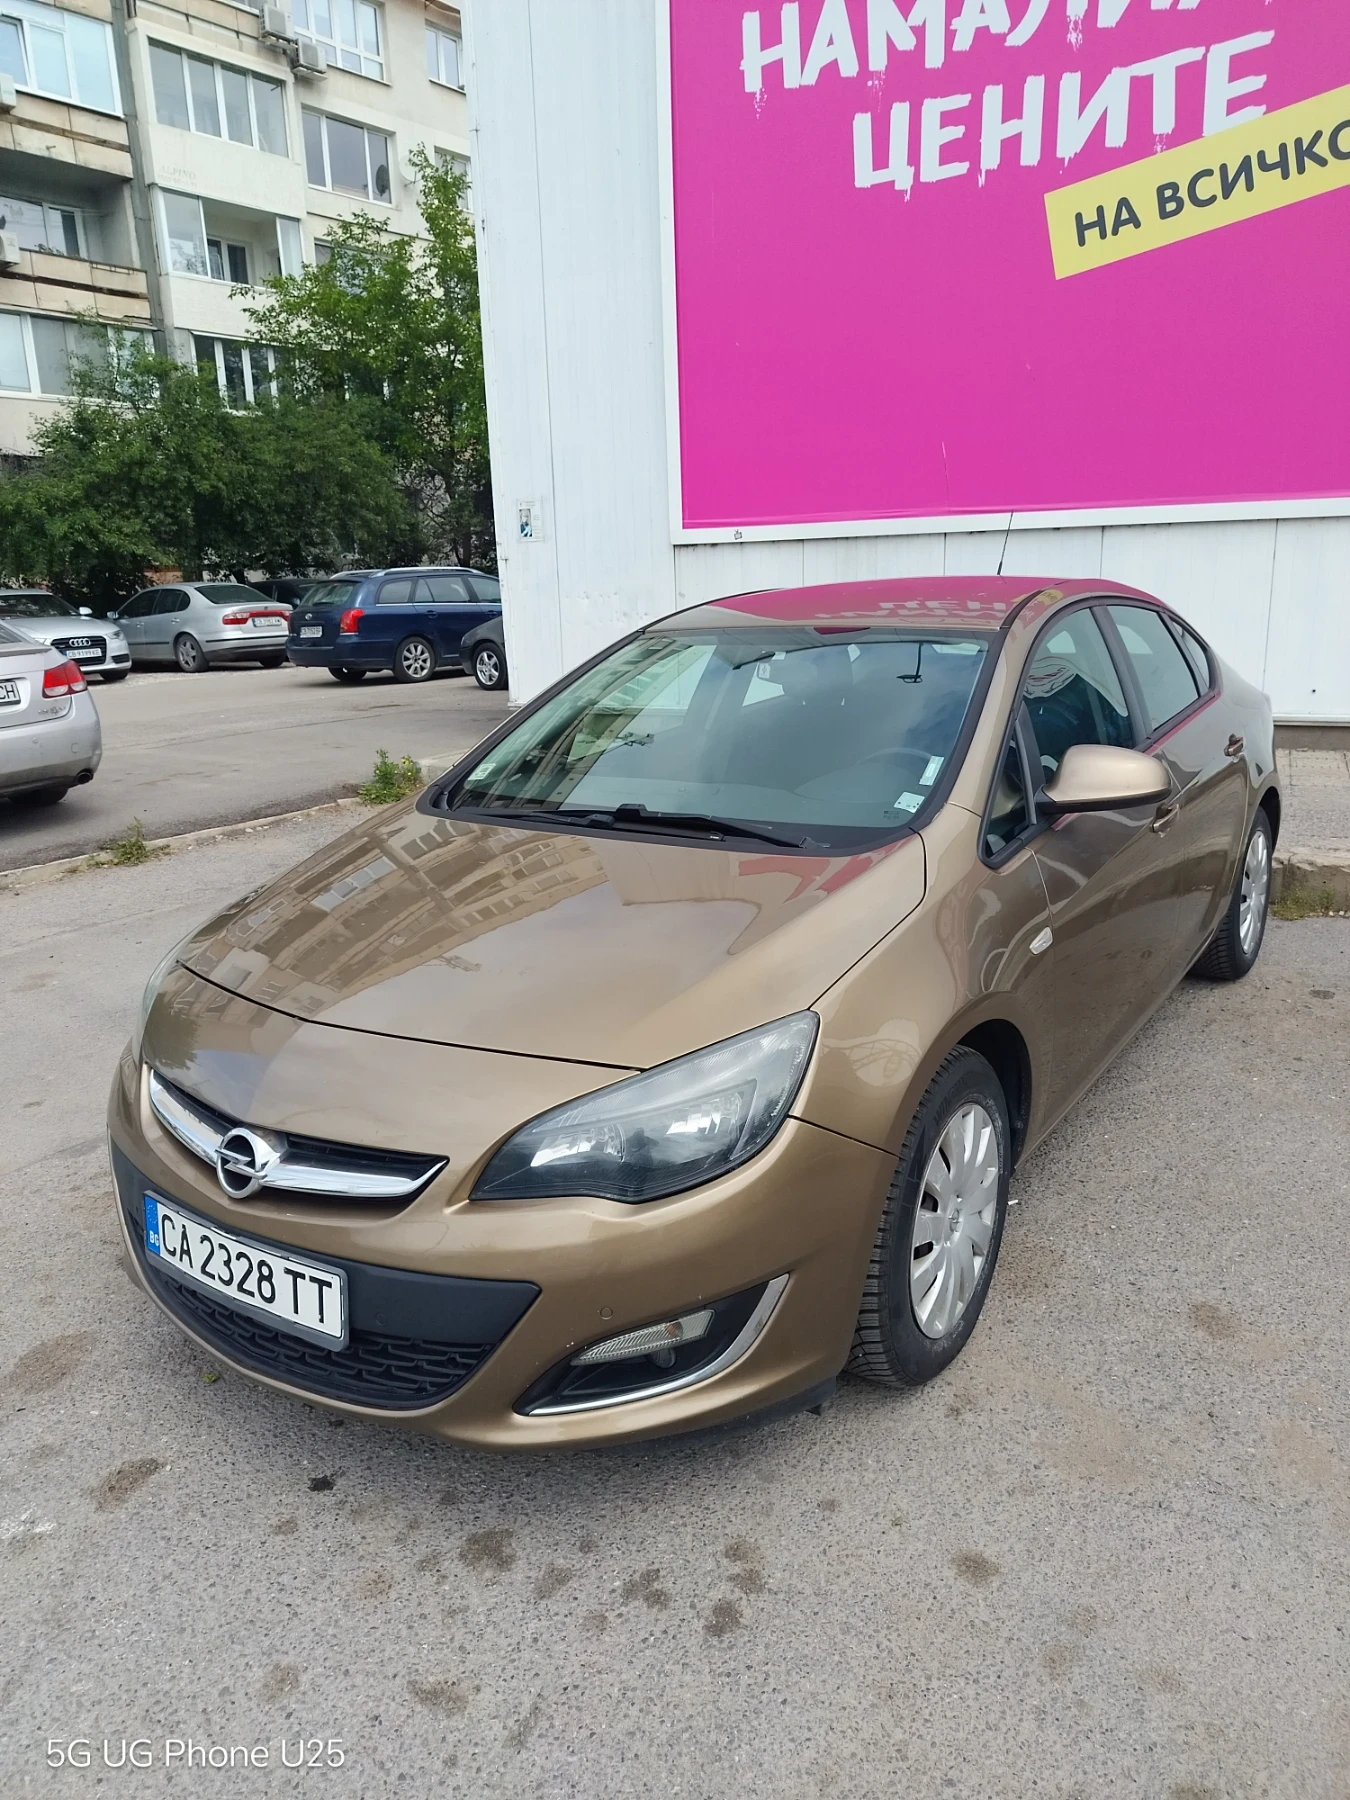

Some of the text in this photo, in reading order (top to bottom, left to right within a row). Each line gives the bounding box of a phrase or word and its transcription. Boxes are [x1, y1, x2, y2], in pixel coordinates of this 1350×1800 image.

[852, 30, 1275, 190] ЦЕНИТЕ
[1075, 196, 1141, 247] НА
[149, 1213, 333, 1324] BG CA 2328 TT
